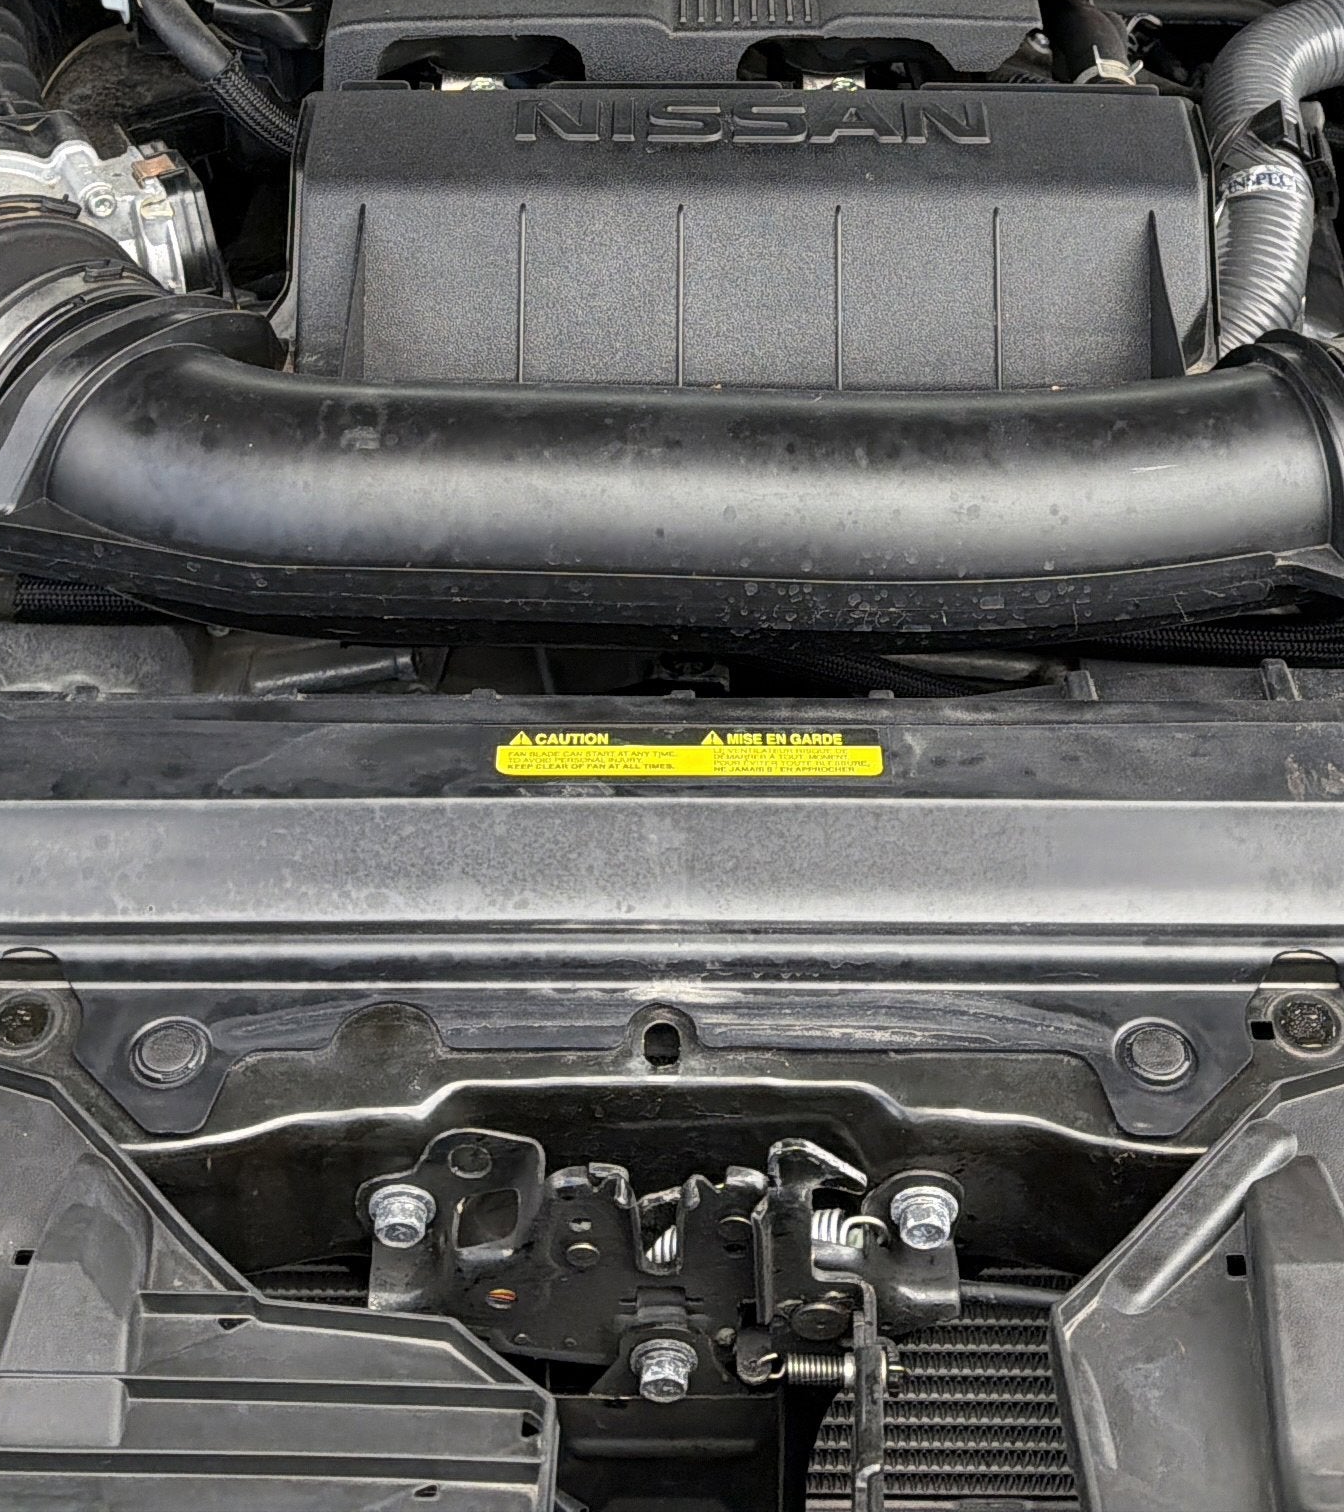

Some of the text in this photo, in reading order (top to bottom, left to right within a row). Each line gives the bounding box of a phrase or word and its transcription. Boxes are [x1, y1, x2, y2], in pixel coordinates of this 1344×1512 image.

[513, 98, 991, 146] NISSAN
[535, 733, 609, 745] CAUTION
[727, 733, 842, 745] MISE EN GARDE
